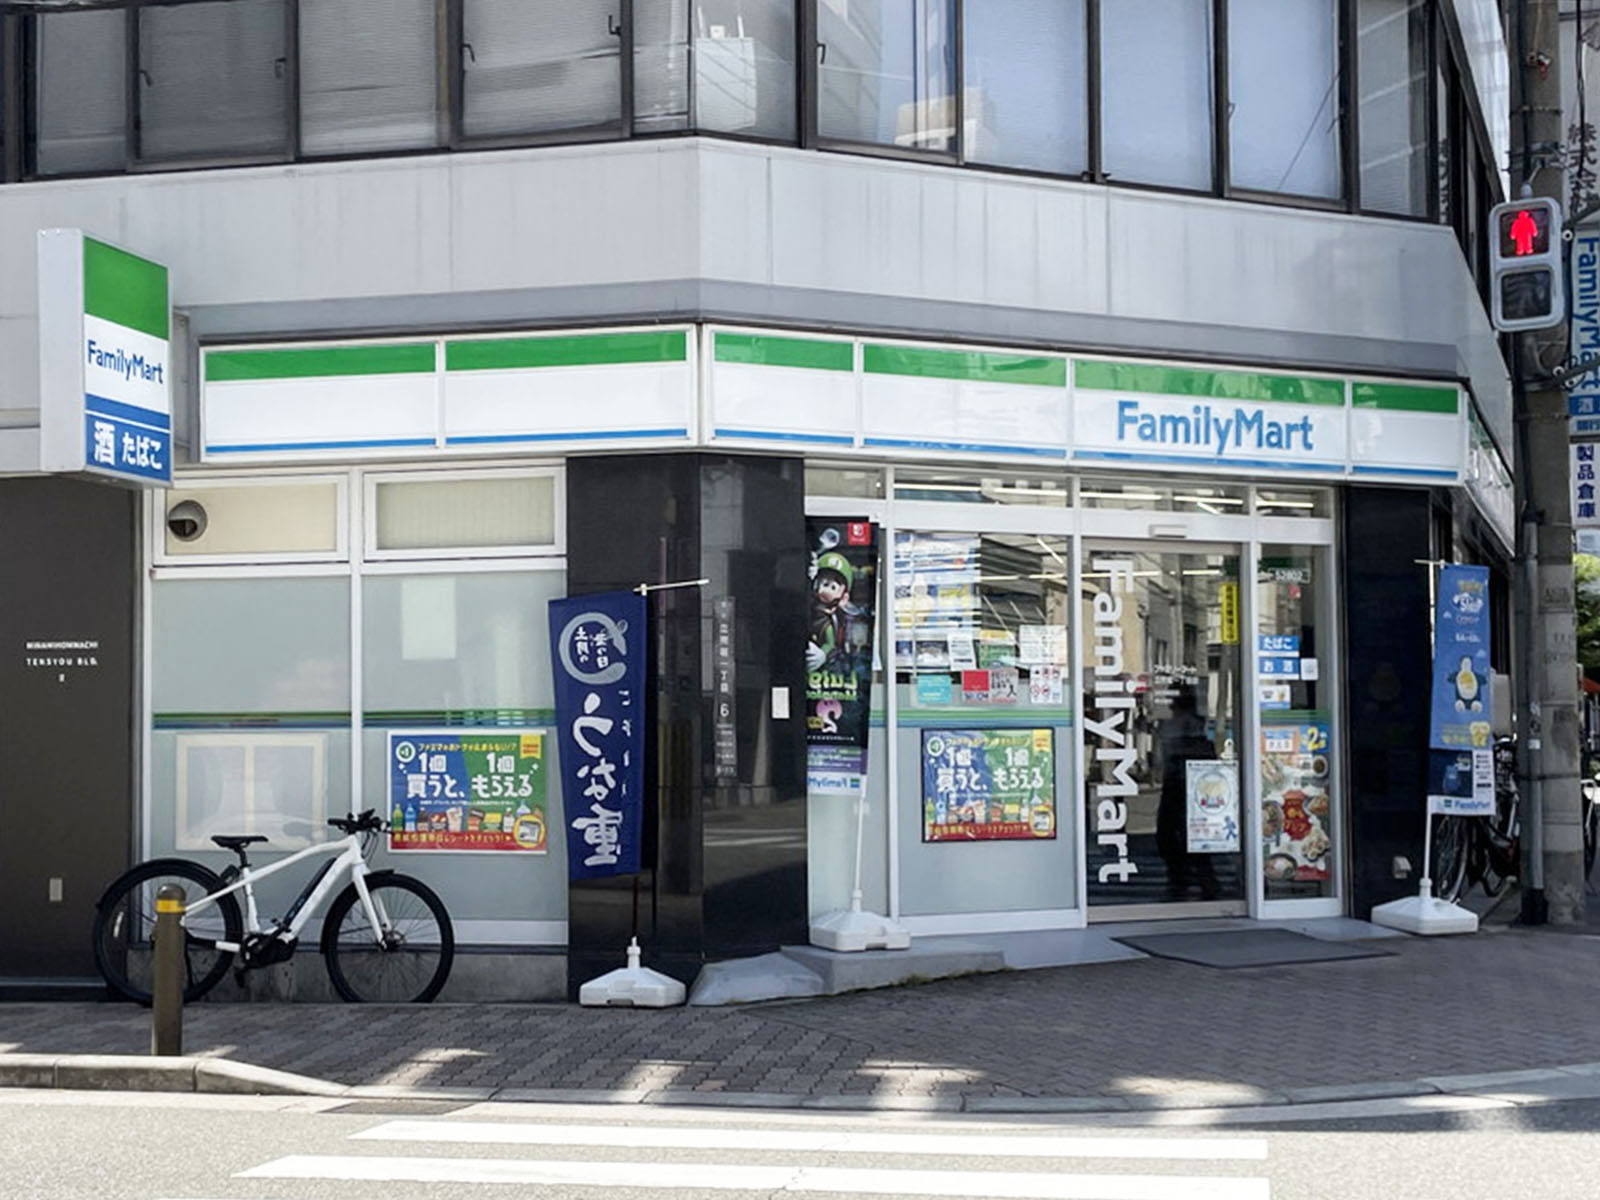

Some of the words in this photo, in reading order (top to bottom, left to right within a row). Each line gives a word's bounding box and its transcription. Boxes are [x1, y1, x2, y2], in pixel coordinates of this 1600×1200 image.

[87, 339, 164, 384] FamilyMart
[1117, 400, 1314, 456] FamilyMart
[93, 421, 116, 466] 酒
[121, 431, 163, 470] たばこ
[1577, 445, 1596, 518] 製品倉庫
[1263, 636, 1294, 650] たばこ
[720, 703, 730, 718] 6
[1084, 559, 1140, 884] FamilyMart
[418, 753, 447, 773] 1個
[486, 753, 515, 773] 1個
[945, 746, 972, 767] 1個
[1005, 746, 1030, 767] 1個
[407, 774, 465, 799] 買うと、
[471, 774, 533, 799] もらえる
[937, 766, 988, 793] 買うと、
[992, 766, 1045, 791] もらえる
